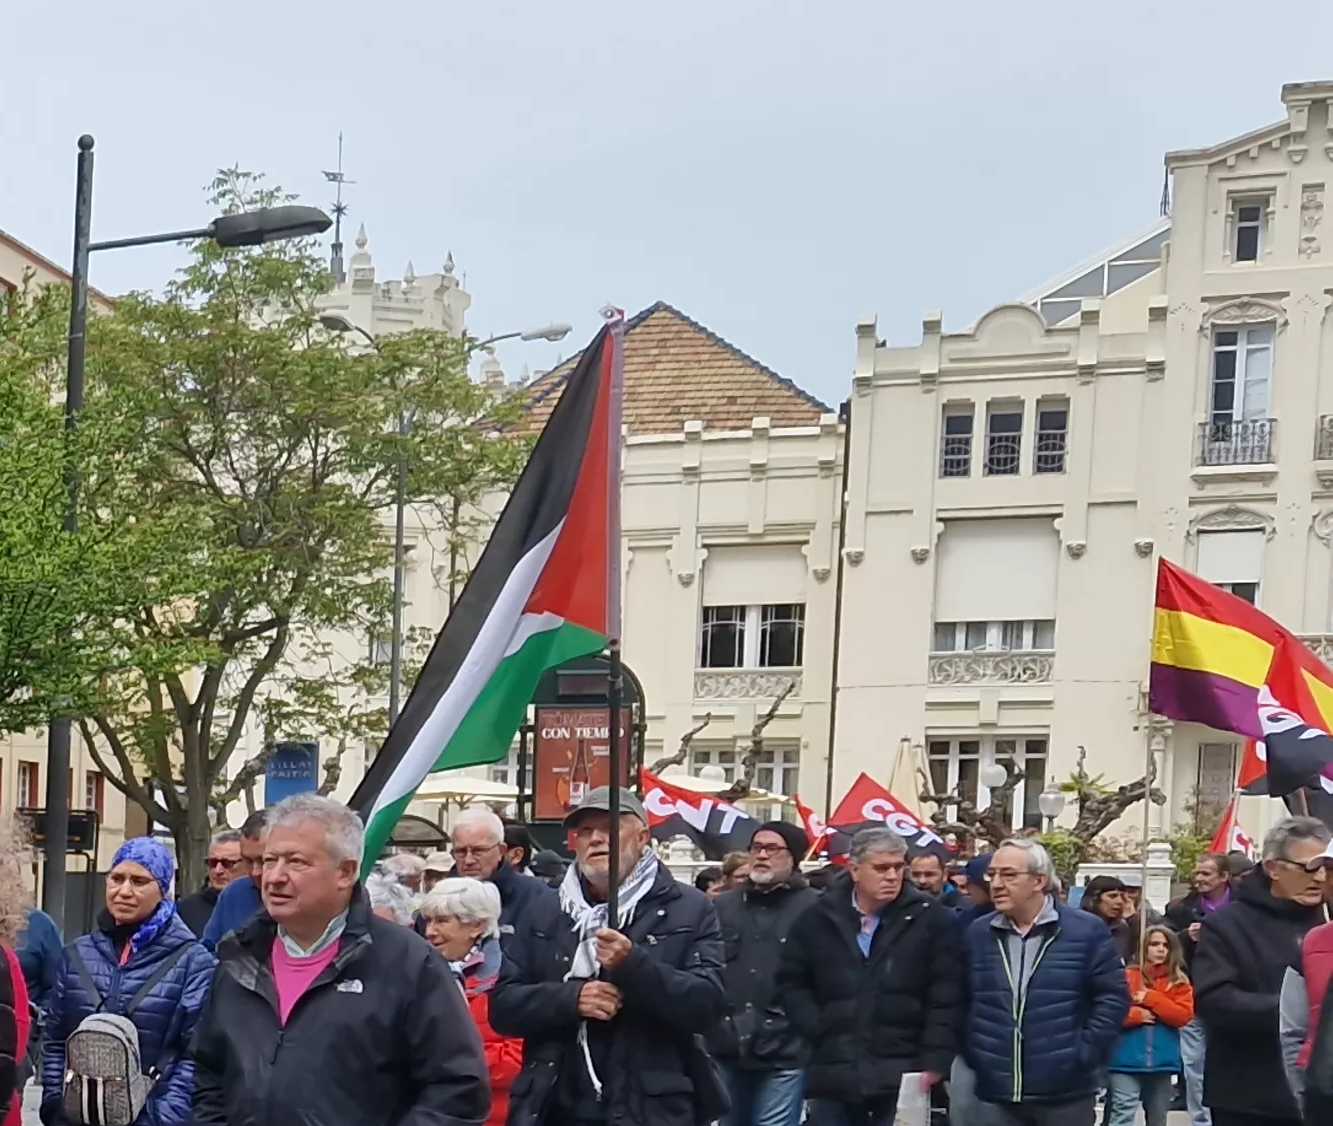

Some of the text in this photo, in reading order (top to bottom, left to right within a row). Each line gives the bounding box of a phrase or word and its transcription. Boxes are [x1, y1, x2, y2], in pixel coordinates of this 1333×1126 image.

[541, 727, 625, 739] CON TIEMO
[645, 787, 750, 834] CNT
[861, 798, 944, 847] CGT
